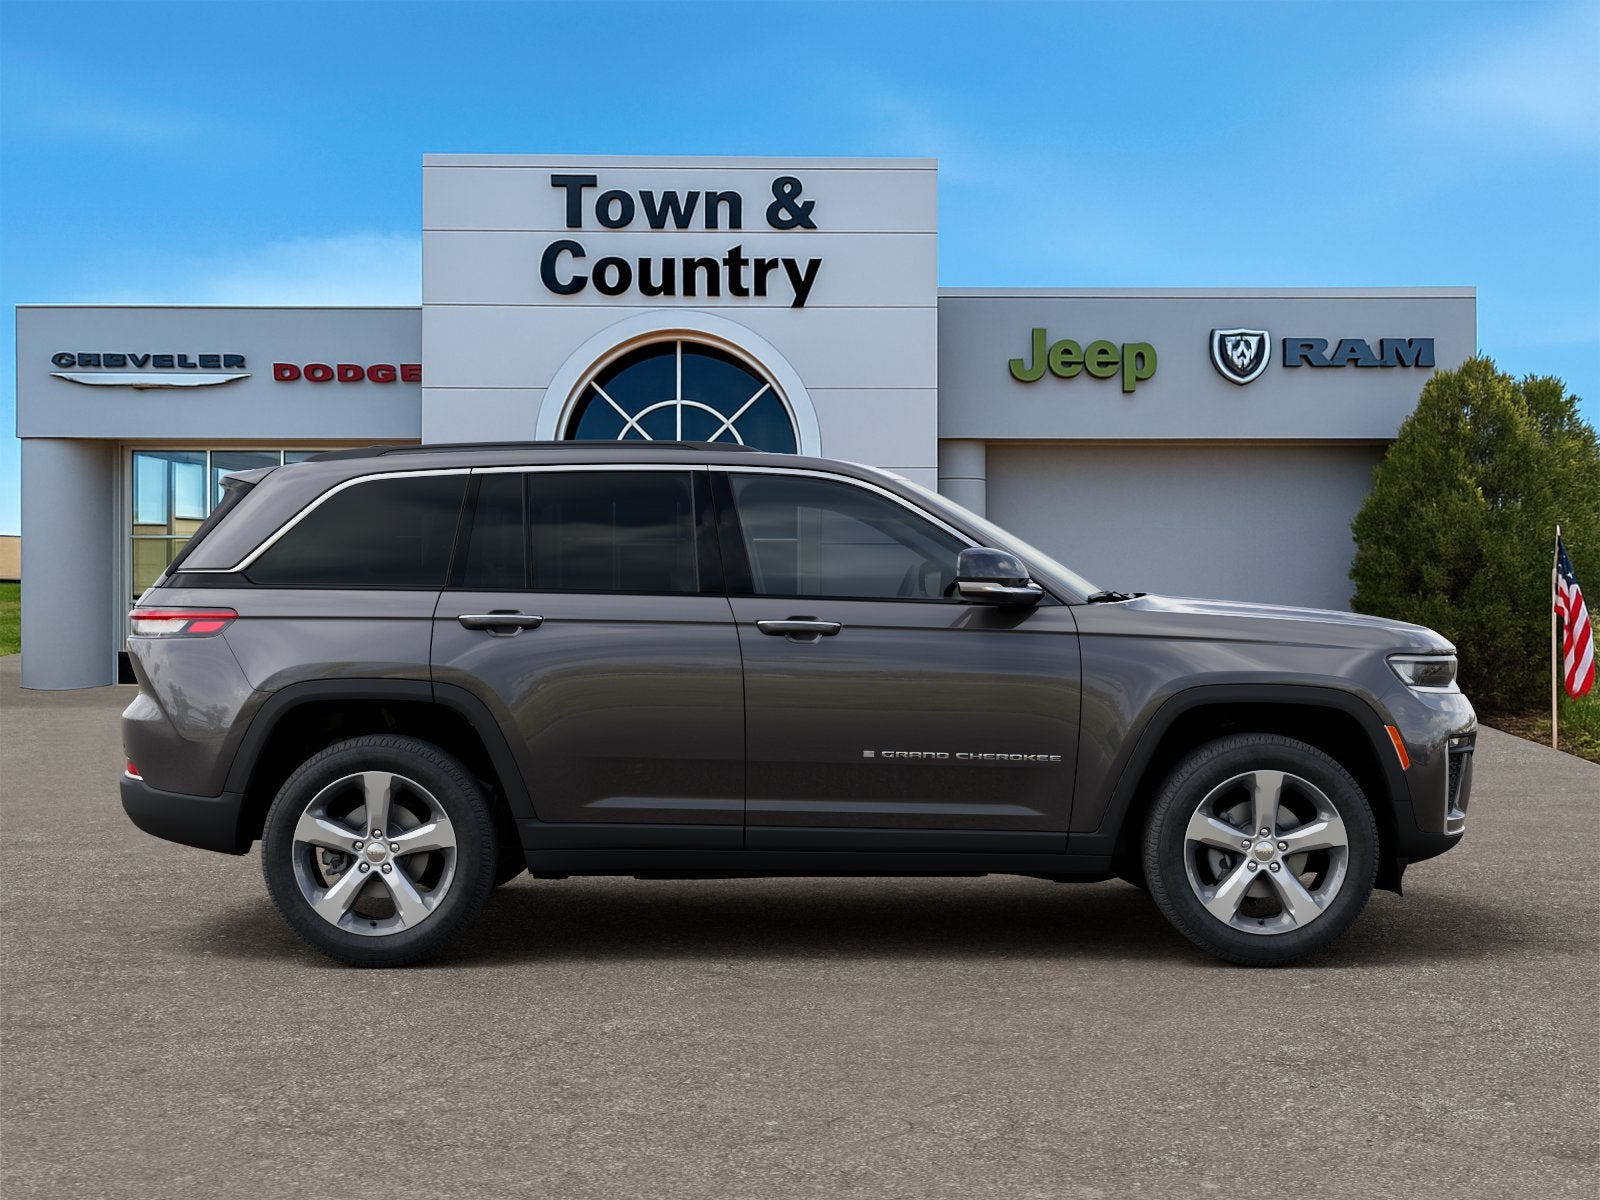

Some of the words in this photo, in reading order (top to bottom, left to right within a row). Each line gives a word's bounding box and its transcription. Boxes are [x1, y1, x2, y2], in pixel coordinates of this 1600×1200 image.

[550, 174, 743, 230] Town
[765, 175, 818, 230] &
[539, 239, 823, 308] Country
[272, 362, 422, 383] DODGE
[1008, 327, 1158, 393] Jeep
[1282, 337, 1435, 368] RAM
[881, 750, 950, 759] GRAND
[955, 752, 1062, 762] CHEROKEE
